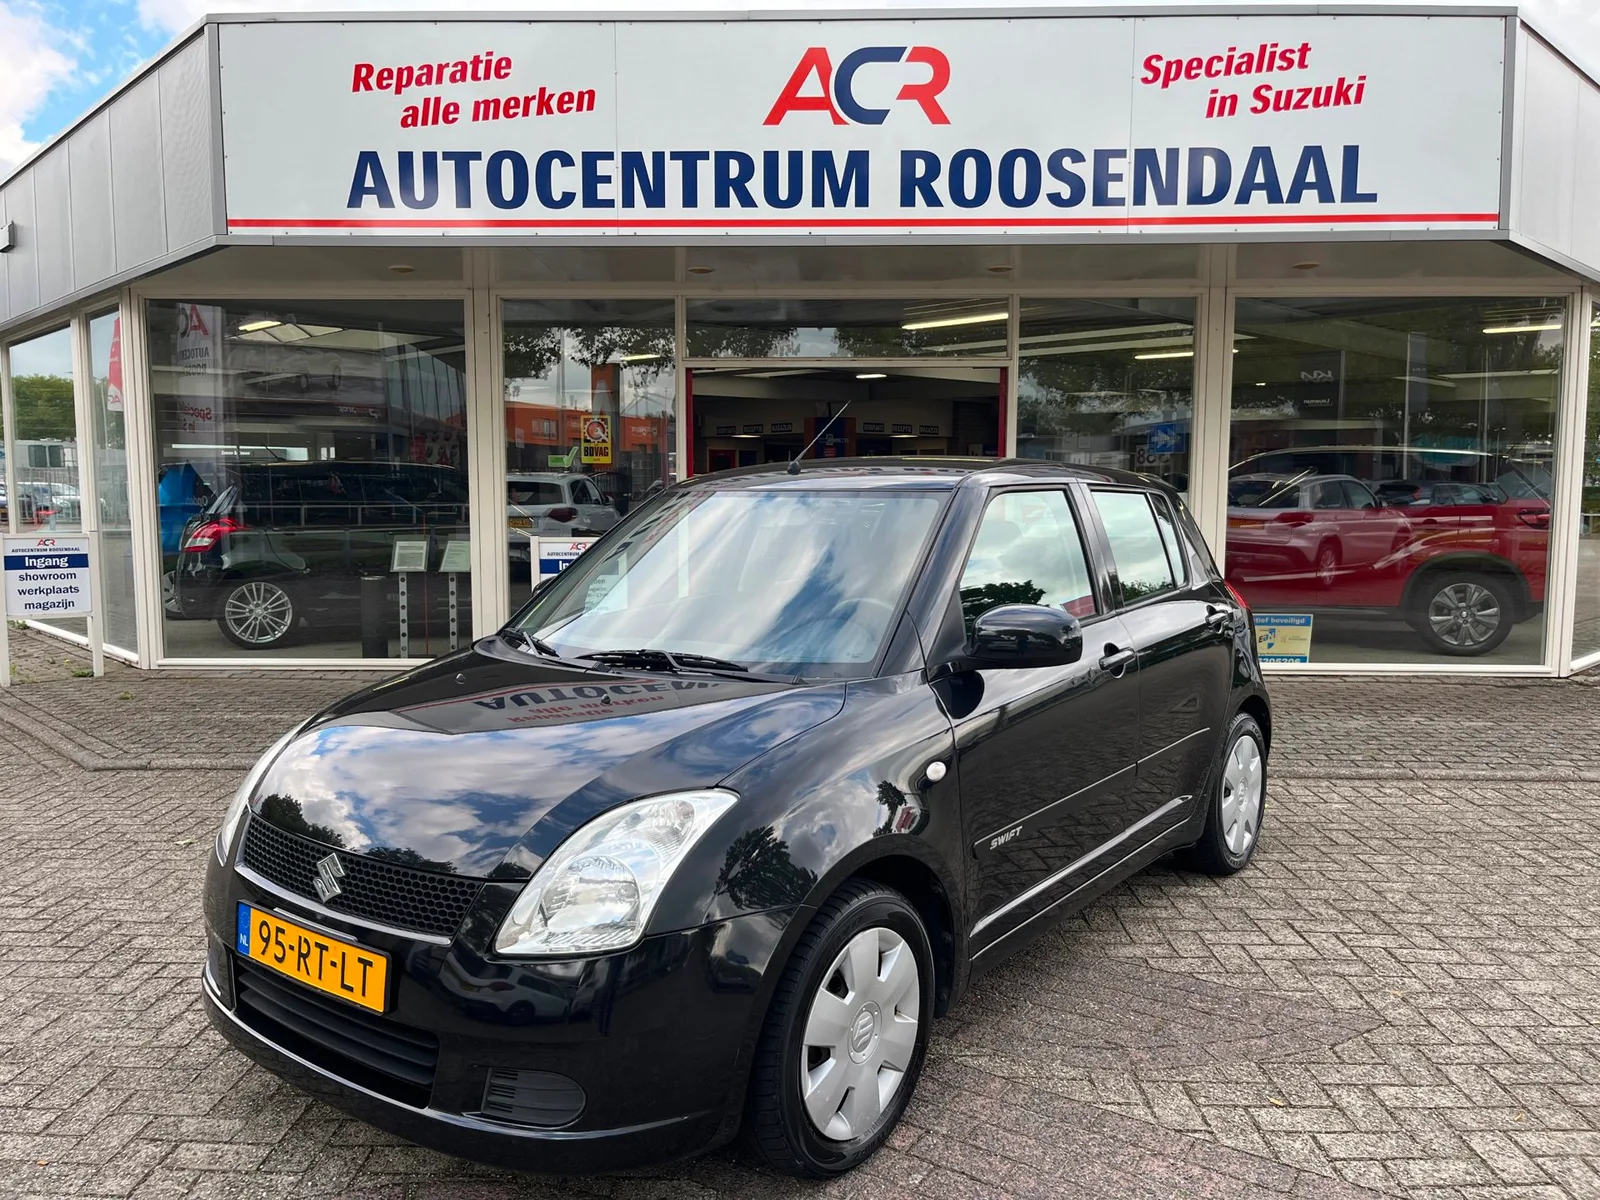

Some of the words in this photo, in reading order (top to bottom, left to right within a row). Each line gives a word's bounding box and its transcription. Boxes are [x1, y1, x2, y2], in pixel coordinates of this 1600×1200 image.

[1140, 42, 1311, 89] Specialist
[352, 51, 512, 95] Reparatie
[763, 46, 951, 126] ACR
[1205, 88, 1239, 119] in
[1250, 75, 1367, 114] Suzuki
[400, 97, 460, 128] alle
[472, 87, 596, 122] merken
[347, 150, 869, 209] AUTOCENTRUM
[900, 145, 1378, 208] ROOSENDAAL
[584, 446, 609, 457] BOVAG
[37, 538, 56, 547] ACR
[570, 542, 587, 551] ACR
[25, 556, 69, 569] Ingang
[18, 571, 77, 582] showroom
[17, 585, 80, 597] werkplaats
[24, 599, 75, 611] magazijn
[1271, 617, 1306, 625] beveiligd
[989, 825, 1023, 850] SWIFT
[239, 933, 249, 947] NL
[258, 919, 374, 997] 95-RT-LT
